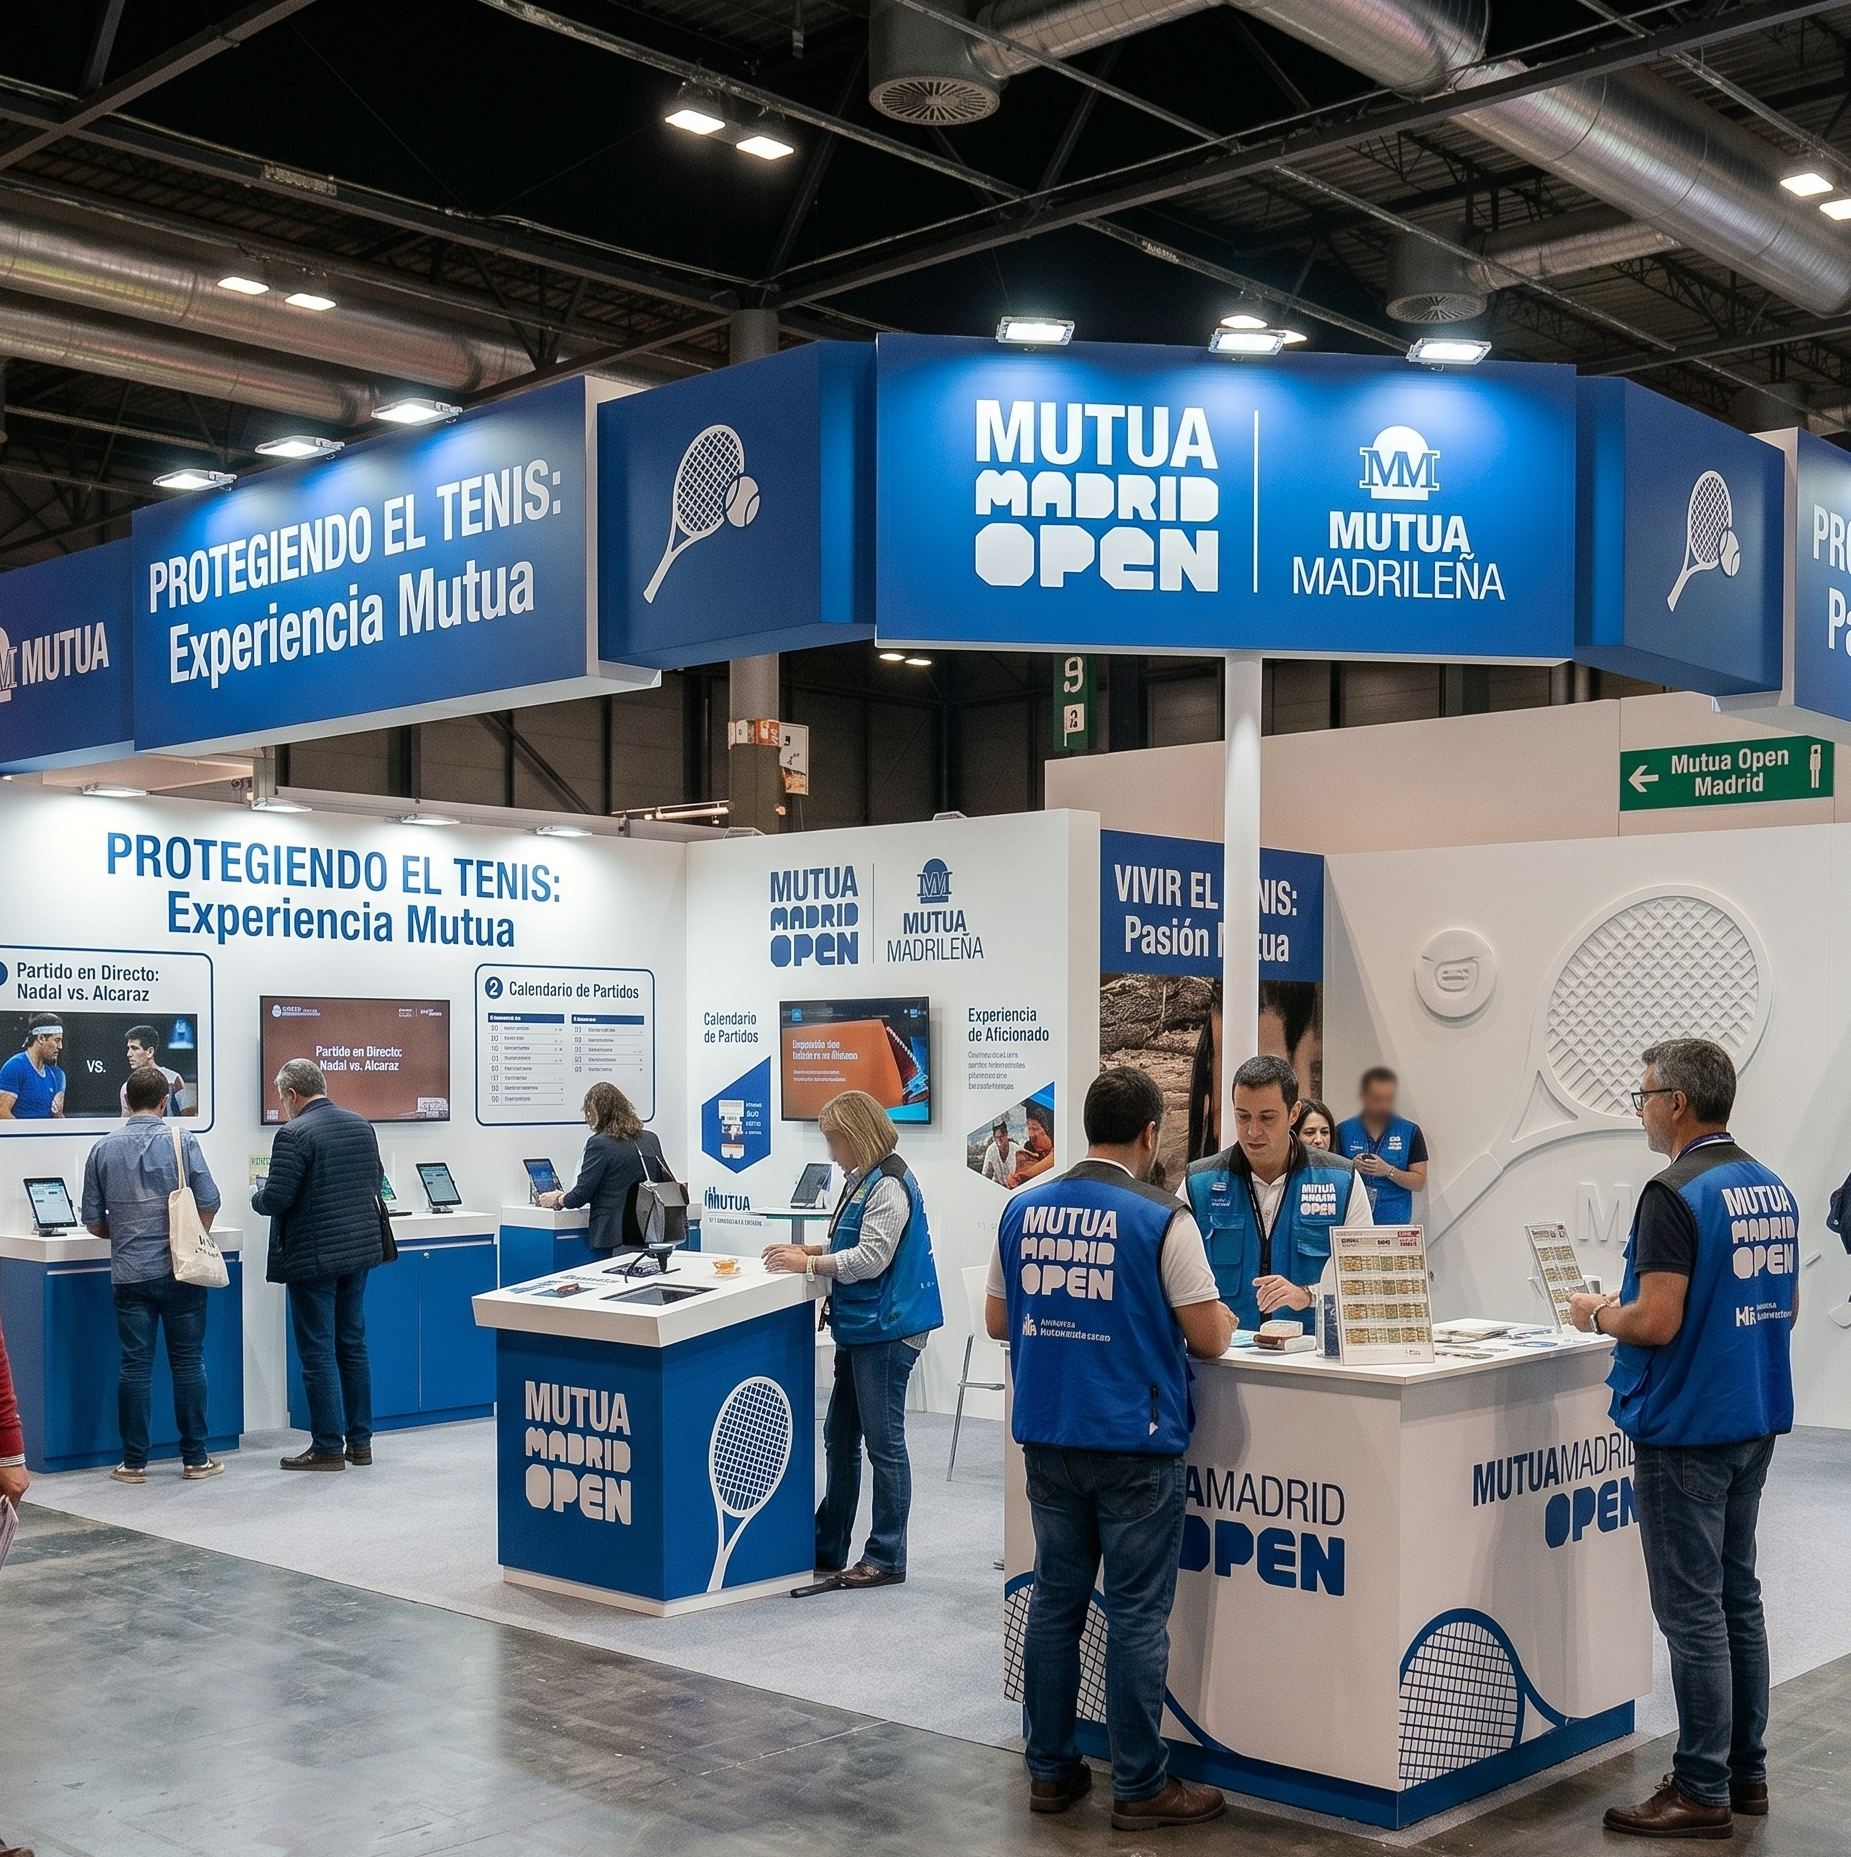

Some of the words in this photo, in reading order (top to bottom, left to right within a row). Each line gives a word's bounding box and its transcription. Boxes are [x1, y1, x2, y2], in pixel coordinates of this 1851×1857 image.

[976, 399, 1219, 470] MUTUA
[975, 469, 1219, 522] MADRID
[150, 506, 372, 614] PROTEGIENDO
[384, 493, 426, 557] EL
[436, 459, 561, 542] TENIS:
[1329, 511, 1472, 554] MUTUA
[975, 522, 1219, 592] OPEN
[1292, 552, 1506, 601] MADRILEÑA
[169, 583, 384, 690] Experiencia
[399, 559, 535, 637] Mutua
[22, 621, 110, 686] MUTUA
[1671, 753, 1732, 774] Mutua
[1738, 748, 1789, 772] Open
[1695, 772, 1764, 797] Madrid
[107, 832, 388, 892] PROTEGIENDO
[402, 855, 442, 895] EL
[453, 858, 560, 903] TENIS:
[770, 865, 859, 903] MUTUA
[1114, 864, 1182, 907] VIVIR
[1190, 871, 1219, 909] EL
[1258, 878, 1298, 916] NIS:
[168, 890, 393, 945] Experiencia
[407, 905, 515, 947] Mutua
[770, 902, 859, 931] MADRID
[903, 910, 967, 934] MUTUA
[770, 931, 859, 968] OPEN
[887, 933, 985, 963] MADRILEÑA
[1125, 915, 1209, 957] Pasión
[17, 962, 73, 980] Partido
[77, 967, 96, 980] en
[101, 965, 159, 982] Directo:
[489, 980, 499, 996] 2
[509, 981, 573, 997] Calendario
[577, 983, 590, 998] de
[593, 984, 640, 999] Partidos
[17, 983, 62, 1000] Nadal
[67, 988, 89, 1001] vs.
[93, 985, 150, 1002] Alcaraz
[704, 1011, 757, 1026] Calendario
[968, 1006, 1037, 1025] Experiencia
[704, 1031, 716, 1043] de
[718, 1029, 759, 1043] Partidos
[968, 1027, 982, 1042] de
[985, 1026, 1050, 1042] Aficionado
[86, 1060, 107, 1073] VS.
[319, 1060, 347, 1071] Nadal
[349, 1061, 363, 1072] vs.
[364, 1060, 400, 1071] Alcaraz
[353, 1048, 364, 1057] en
[1721, 1185, 1793, 1217] MUTUA
[1022, 1206, 1117, 1239] MUTUA
[1731, 1216, 1796, 1244] MADRID
[1021, 1237, 1115, 1265] MADRID
[1733, 1244, 1794, 1279] OPEN
[1021, 1263, 1114, 1301] OPEN
[525, 1380, 631, 1436] MUTUA
[525, 1427, 631, 1474] MADRID
[526, 1464, 632, 1526] OPEN
[1186, 1465, 1345, 1526] AMADRID
